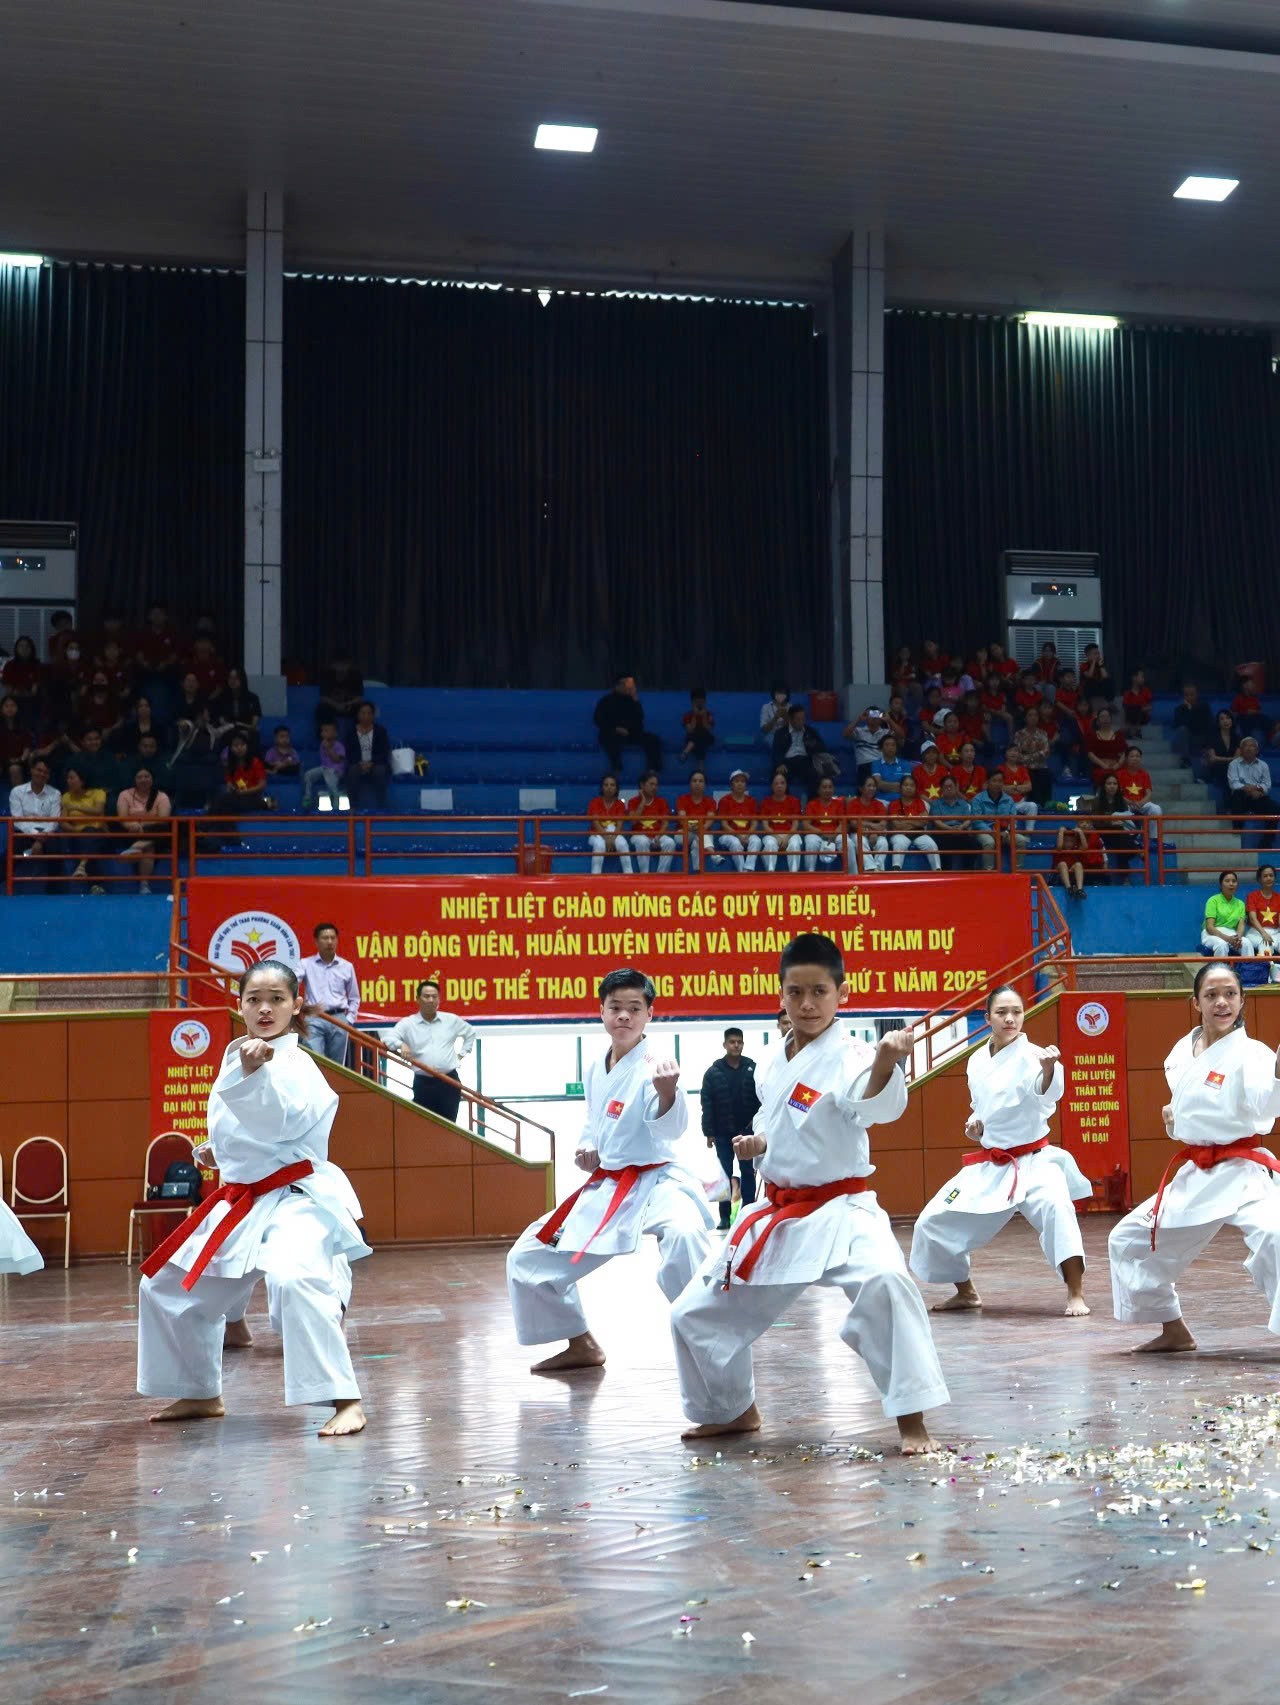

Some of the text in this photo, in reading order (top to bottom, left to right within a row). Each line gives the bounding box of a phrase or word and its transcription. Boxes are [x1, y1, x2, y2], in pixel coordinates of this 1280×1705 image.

[441, 886, 876, 923] NHIỆT LIỆT CHÀO MỪNG CÁC QUÝ VỊ ĐẠI BIỂU,
[356, 931, 398, 963] VẬN
[404, 931, 461, 962] ĐỘNG
[467, 930, 520, 959] VIÊN,
[526, 926, 584, 957] HUẤN
[587, 929, 649, 959] LUYỆN
[655, 928, 699, 954] VIÊN
[706, 927, 731, 953] VÀ
[737, 927, 790, 952] NHÂN
[841, 923, 865, 951] VỀ
[870, 929, 924, 951] THAM
[928, 927, 954, 954] DỰ
[361, 975, 395, 1007] HỘI
[446, 977, 487, 1006] DỤC
[493, 968, 532, 1001] THỂ
[536, 976, 587, 1000] THAO
[680, 971, 733, 997] XUÂN
[845, 968, 872, 993] HỨ
[876, 972, 887, 993] I
[894, 970, 937, 992] NĂM
[943, 970, 988, 992] 2025
[1074, 1053, 1115, 1065] TOÀN DÂN
[167, 1063, 214, 1080] NHIỆT LIỆT
[1071, 1069, 1116, 1082] RÈN LUYỆN
[164, 1081, 212, 1096] CHÀO MỪN
[1075, 1084, 1096, 1097] THÂN
[163, 1101, 179, 1115] ĐẠI
[181, 1099, 196, 1115] HỘI
[1069, 1101, 1120, 1112] THEO GƯƠNG
[1080, 1116, 1097, 1127] BÁC
